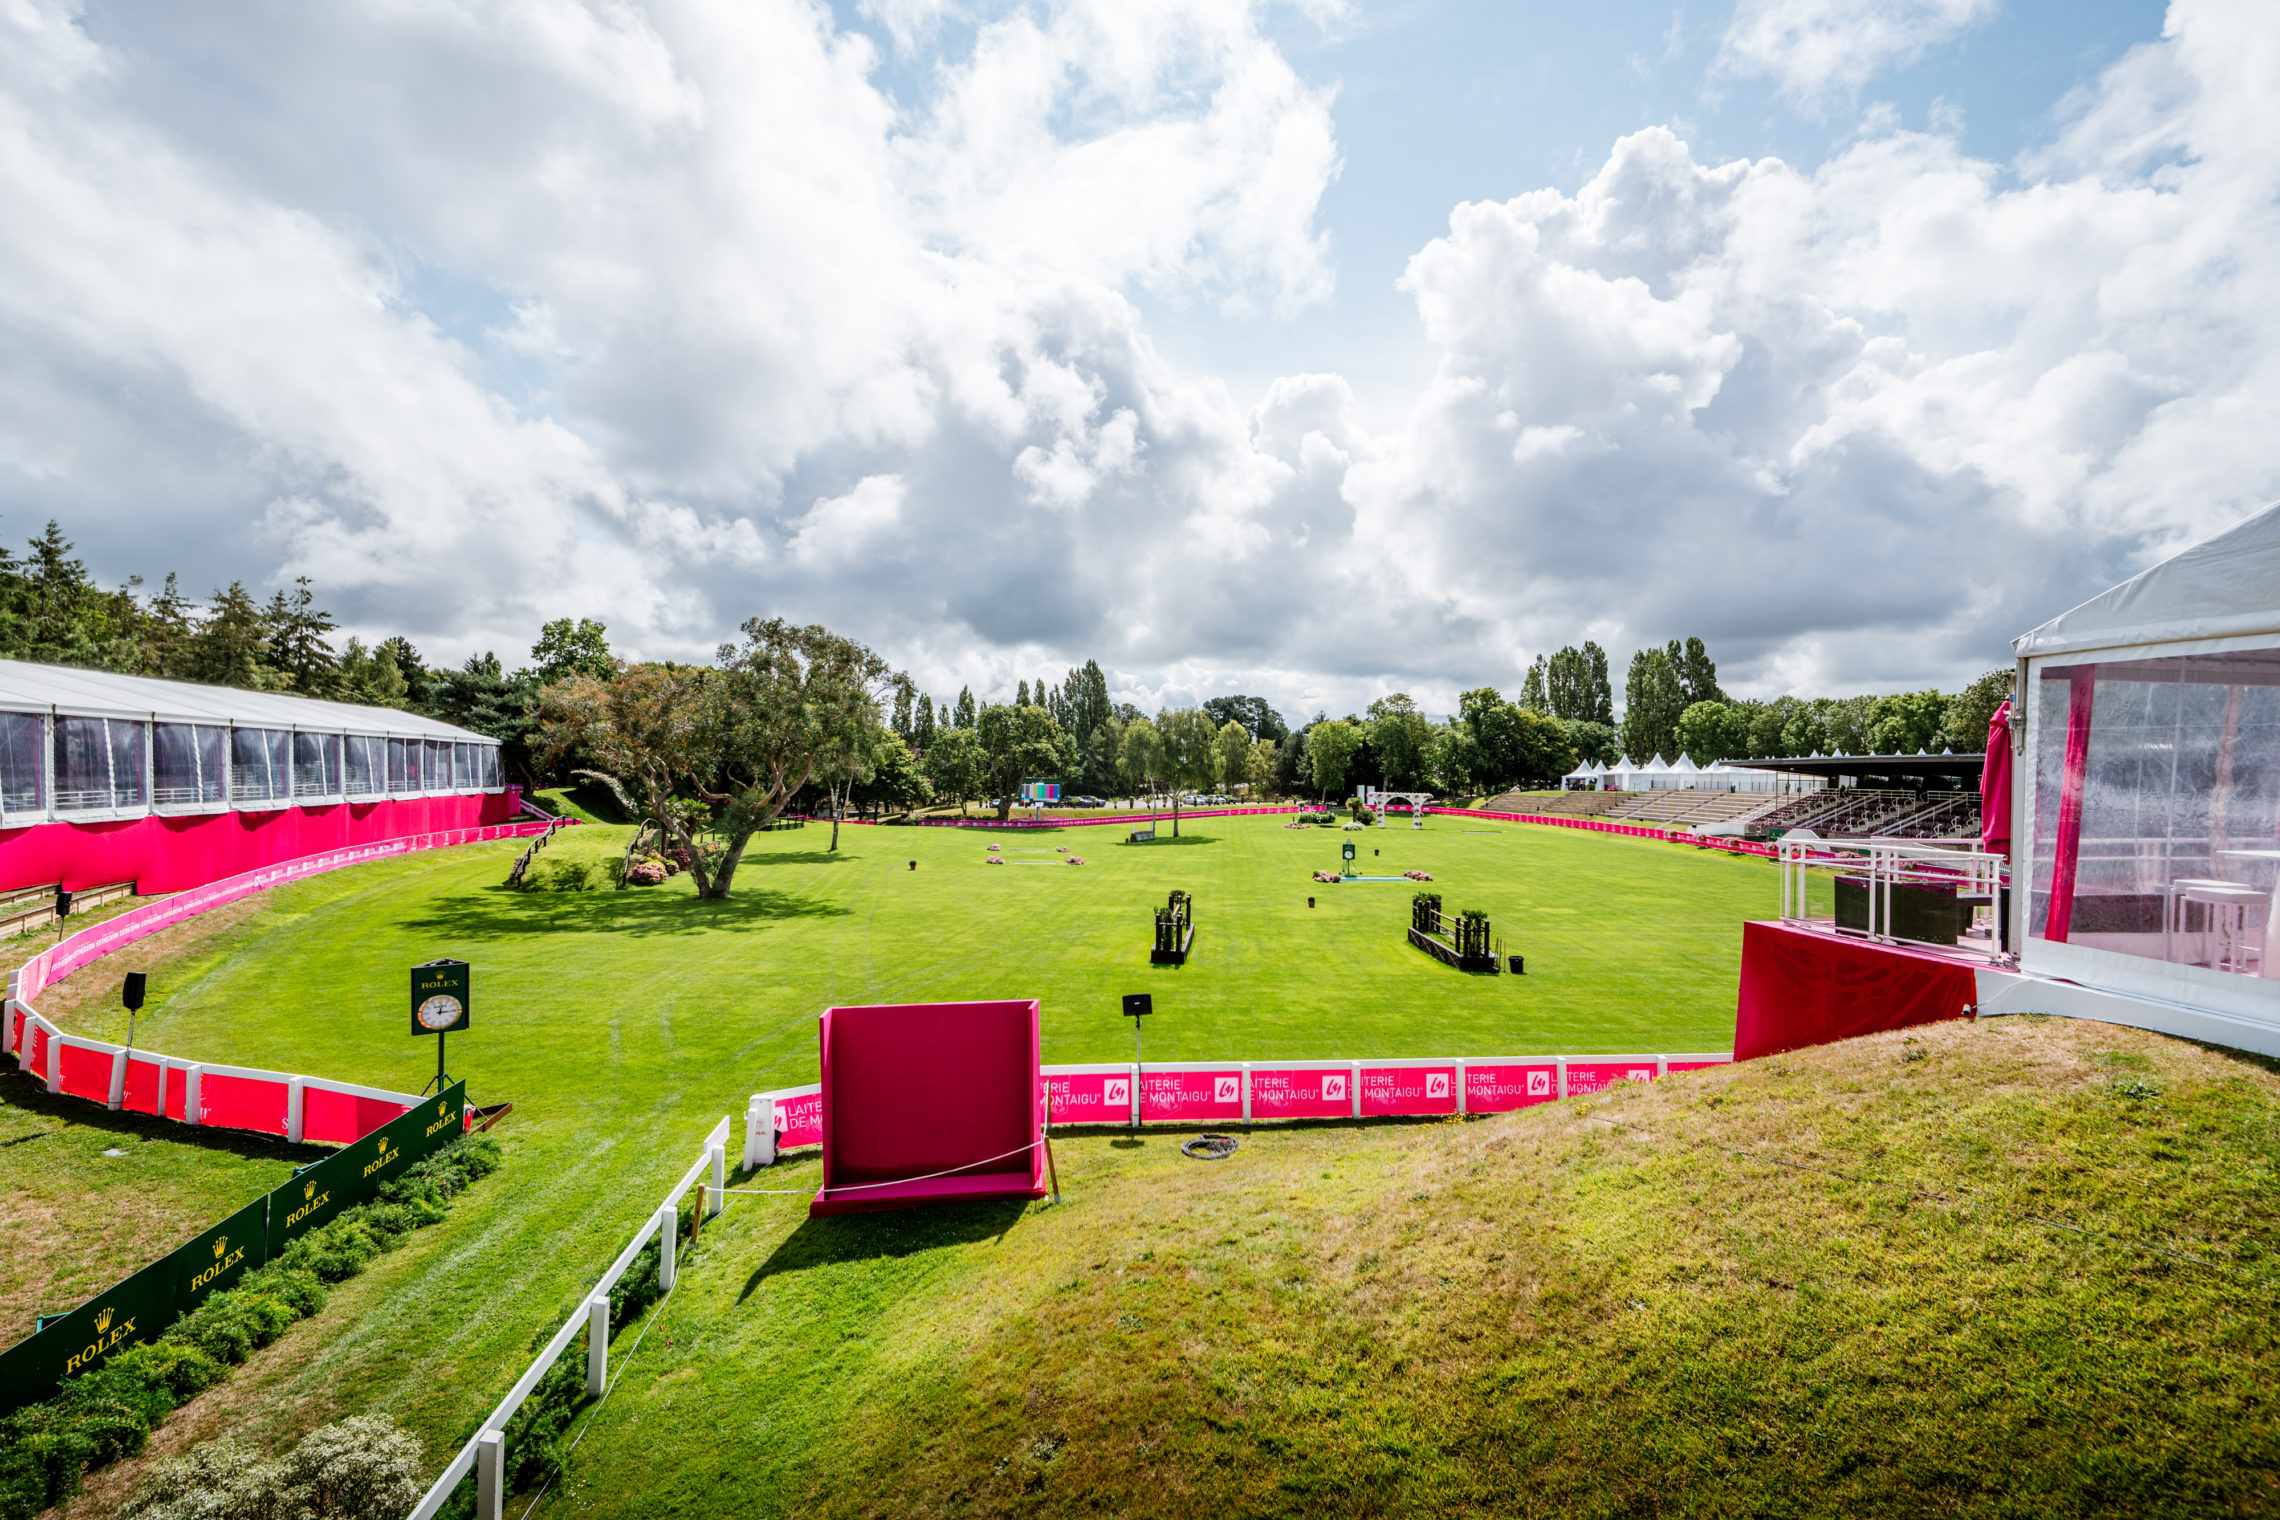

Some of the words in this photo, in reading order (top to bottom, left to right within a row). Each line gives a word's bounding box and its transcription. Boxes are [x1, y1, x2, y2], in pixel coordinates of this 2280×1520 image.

[421, 979, 459, 989] ROLEX
[426, 1111, 456, 1138] ROLEX
[790, 1116, 807, 1129] DE
[363, 1146, 399, 1178] ROLEX
[286, 1190, 330, 1229] ROLEX
[191, 1246, 245, 1292] ROLEX
[65, 1316, 136, 1376] ROLEX
